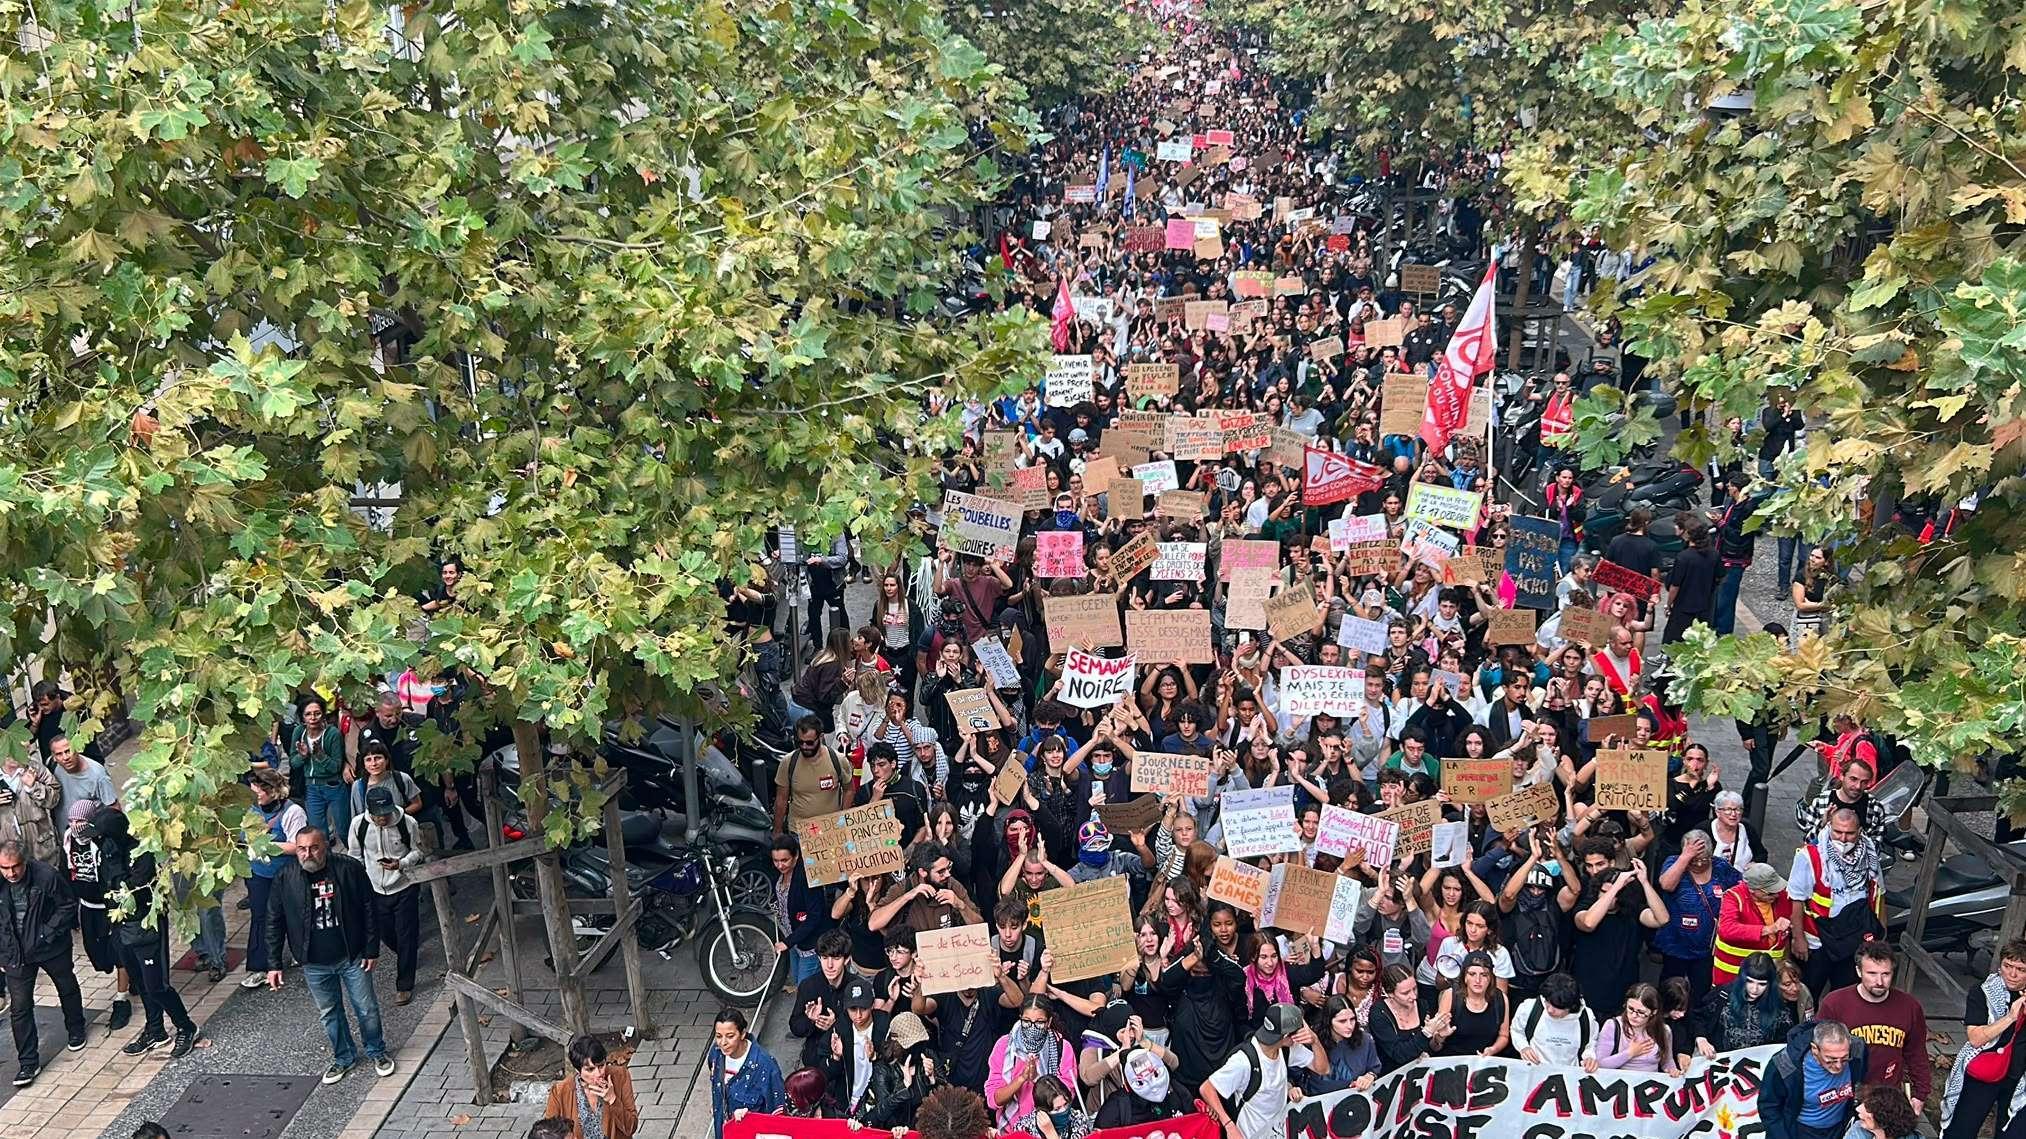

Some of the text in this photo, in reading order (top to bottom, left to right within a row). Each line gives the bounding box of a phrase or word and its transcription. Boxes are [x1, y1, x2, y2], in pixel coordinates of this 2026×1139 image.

[946, 490, 961, 506] LES
[1415, 504, 1427, 515] LE
[1429, 507, 1440, 517] 17
[1475, 547, 1496, 558] PROF
[1040, 566, 1082, 577] FASCISTES
[1286, 681, 1344, 692] MAIS JE
[1290, 700, 1356, 712] DILEMME
[1629, 752, 1645, 763] MA
[1194, 760, 1207, 771] DE
[1446, 761, 1458, 770] LA
[1137, 767, 1170, 778] COURS
[1136, 775, 1156, 785] QUE
[1448, 786, 1459, 796] LE
[1597, 791, 1655, 809] CRITIQUE
[1415, 803, 1430, 815] DE
[845, 803, 888, 828] BUDGET
[851, 822, 894, 842] PANCAR
[810, 849, 828, 862] TE
[1233, 860, 1263, 878] HAPPY
[1214, 866, 1261, 891] HUNGER
[1212, 882, 1263, 907] GAMES
[1287, 1057, 1762, 1138] MOYENS AMPUTÉS
